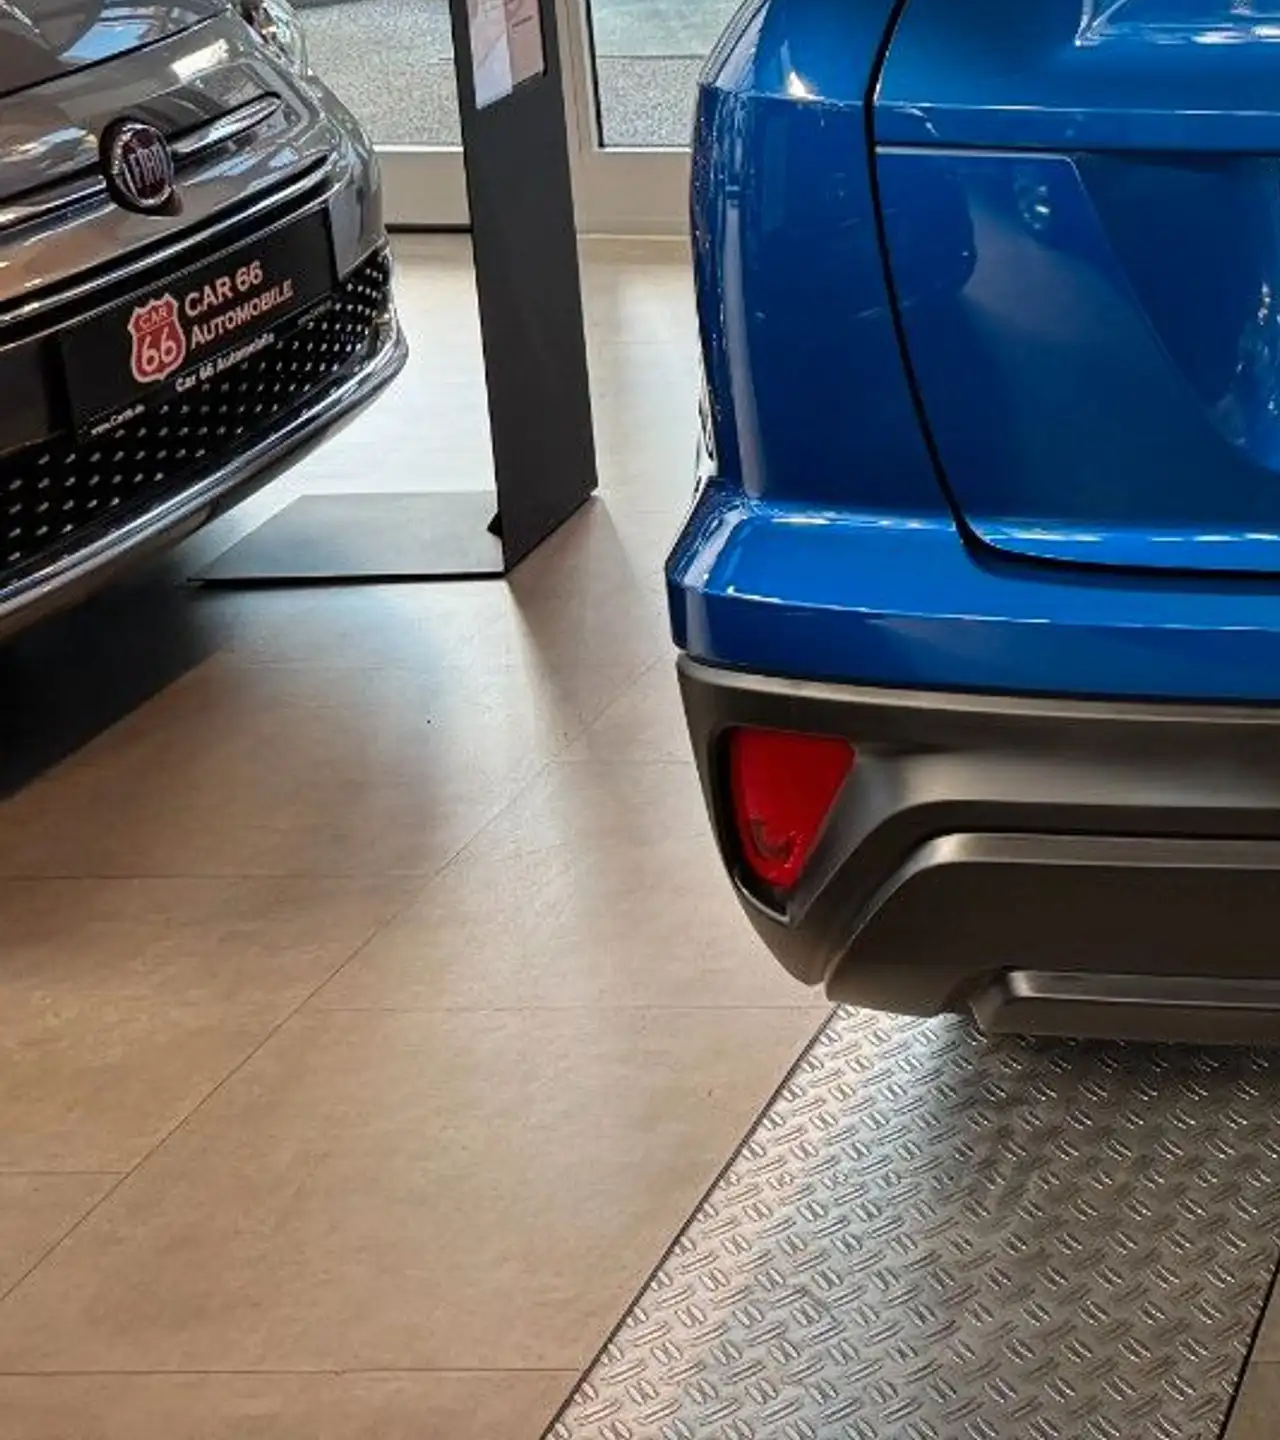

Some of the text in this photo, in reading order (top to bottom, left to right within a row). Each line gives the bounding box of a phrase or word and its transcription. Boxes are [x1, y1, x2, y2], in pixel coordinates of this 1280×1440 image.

[183, 261, 264, 317] CAR 66
[190, 278, 294, 349] AUTOMOBILE
[139, 306, 168, 328] CAR
[141, 327, 177, 372] 66
